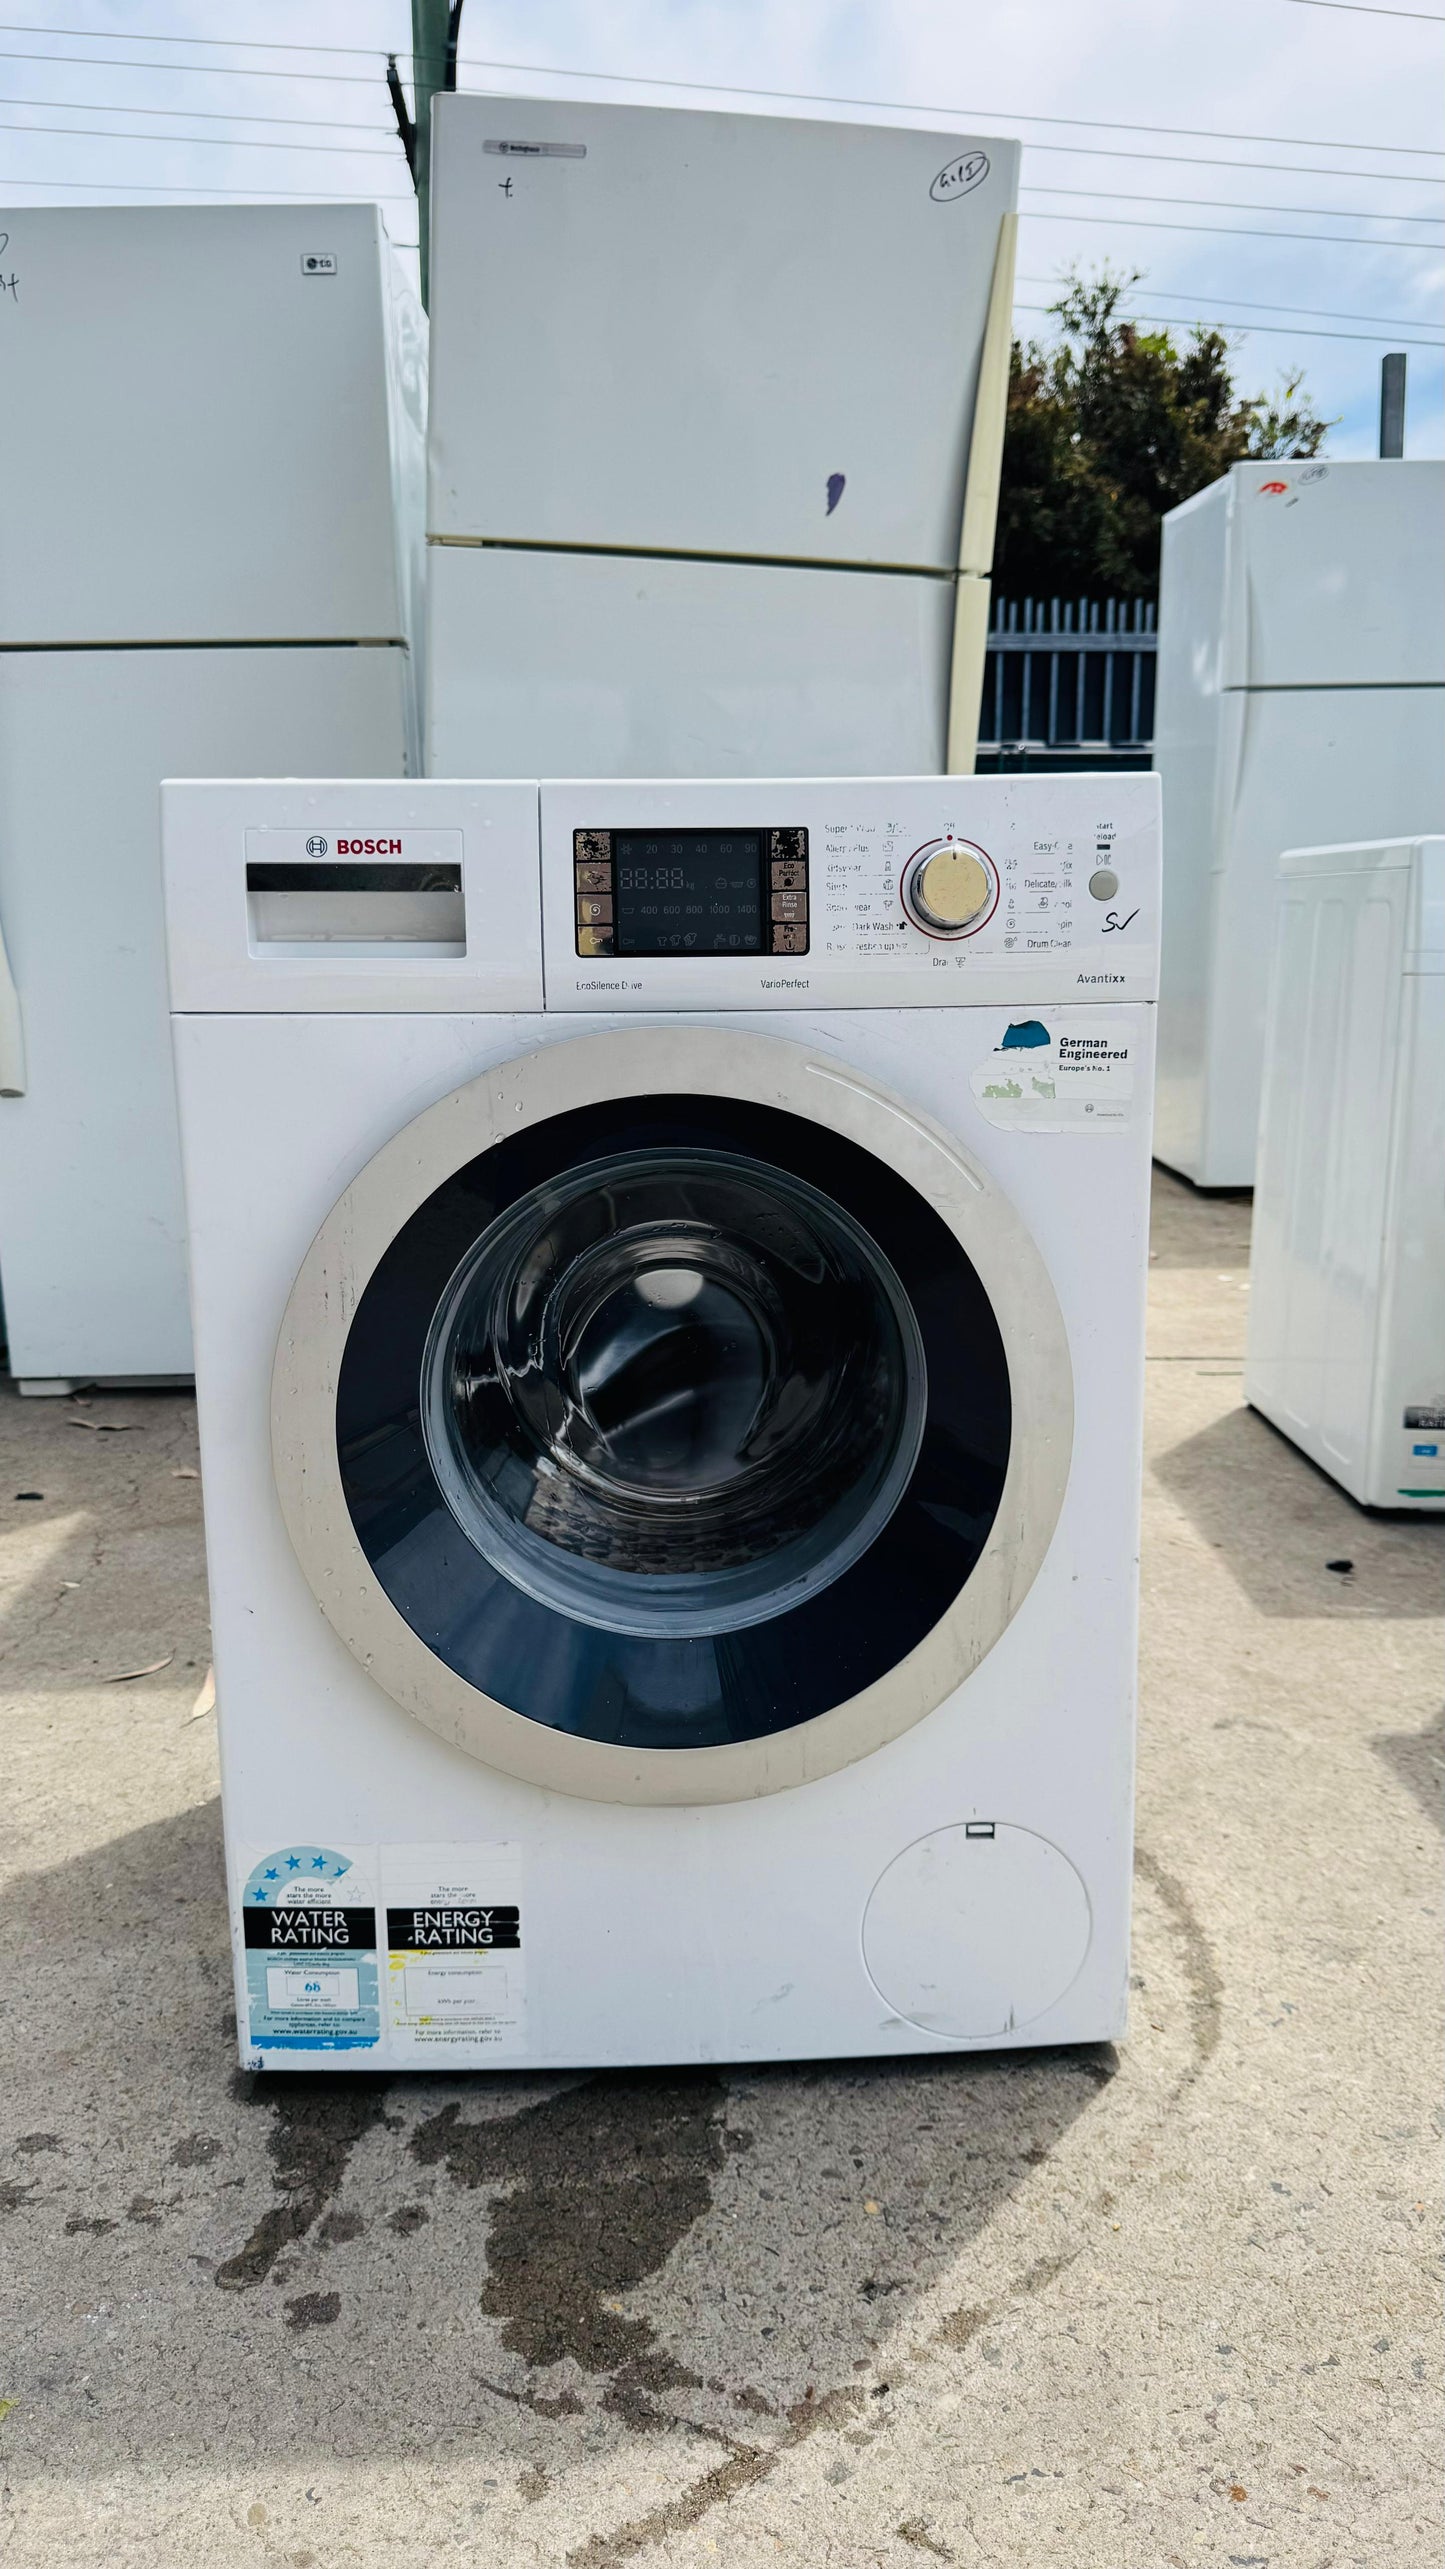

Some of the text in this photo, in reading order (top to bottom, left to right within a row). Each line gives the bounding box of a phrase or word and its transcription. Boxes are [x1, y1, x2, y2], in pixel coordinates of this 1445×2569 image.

[337, 839, 402, 855] BOSCH
[646, 843, 757, 854] 20 30 40 60 90
[641, 905, 757, 915] 400 600 800 1000 1400
[872, 922, 894, 931] Wash
[1027, 939, 1049, 949] Drum
[760, 979, 810, 989] VarioPerfect
[1076, 973, 1126, 984] Avantixx
[1059, 1037, 1108, 1048] German
[1058, 1048, 1129, 1061] Engineered
[1058, 1064, 1090, 1072] Europe's
[271, 1910, 348, 1928] WATER
[413, 1910, 494, 1928] ENERGY
[271, 1927, 350, 1945] RATING
[415, 1927, 494, 1945] RATING
